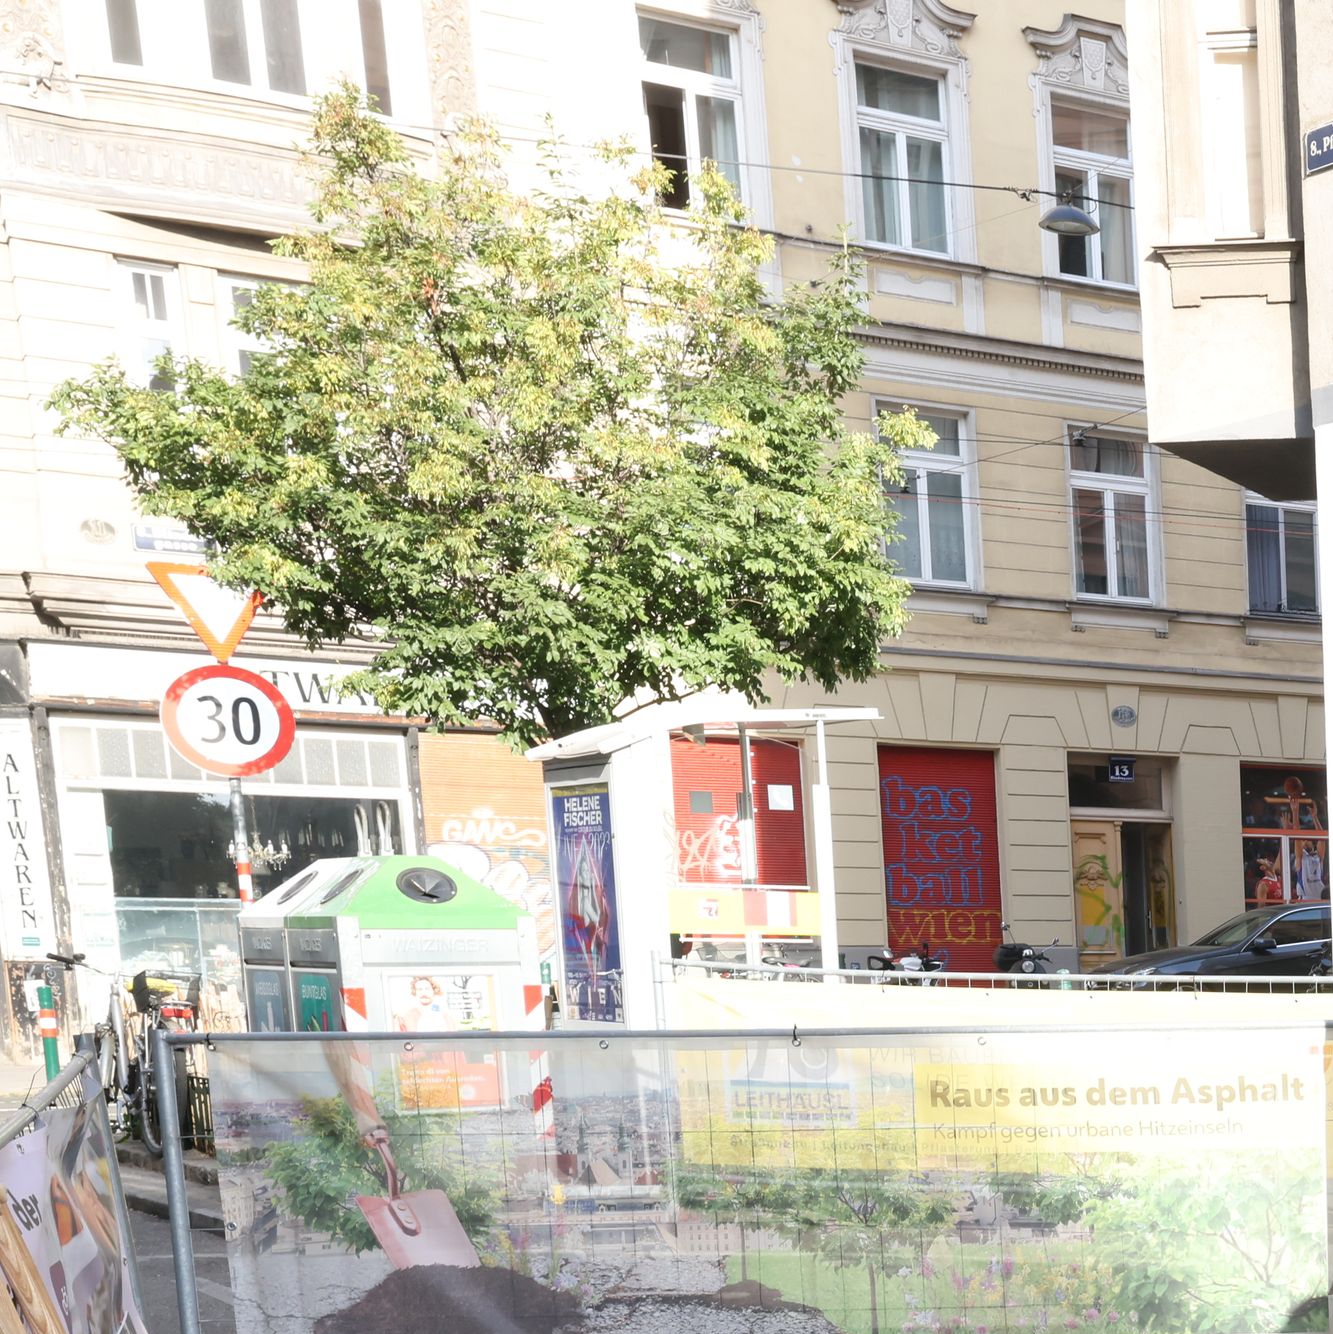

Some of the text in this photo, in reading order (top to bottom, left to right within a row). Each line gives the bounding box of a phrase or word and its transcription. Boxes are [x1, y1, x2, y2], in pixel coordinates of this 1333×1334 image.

[195, 695, 262, 746] 30
[1114, 764, 1130, 777] 13
[564, 796, 601, 812] HELENE
[880, 775, 974, 821] bas
[564, 811, 603, 828] FISCHER
[3, 753, 37, 928] ALTWAREN
[899, 820, 985, 863] ket
[885, 863, 984, 907] ball
[393, 937, 489, 953] WAIZINGER
[929, 1079, 1011, 1108] Raus
[1018, 1085, 1077, 1107] aus
[1086, 1078, 1161, 1106] dem
[1171, 1073, 1305, 1111] Asphalt
[934, 1118, 1244, 1143] Kampf gegen urbane Hitzeinseln
[6, 1188, 43, 1231] der
